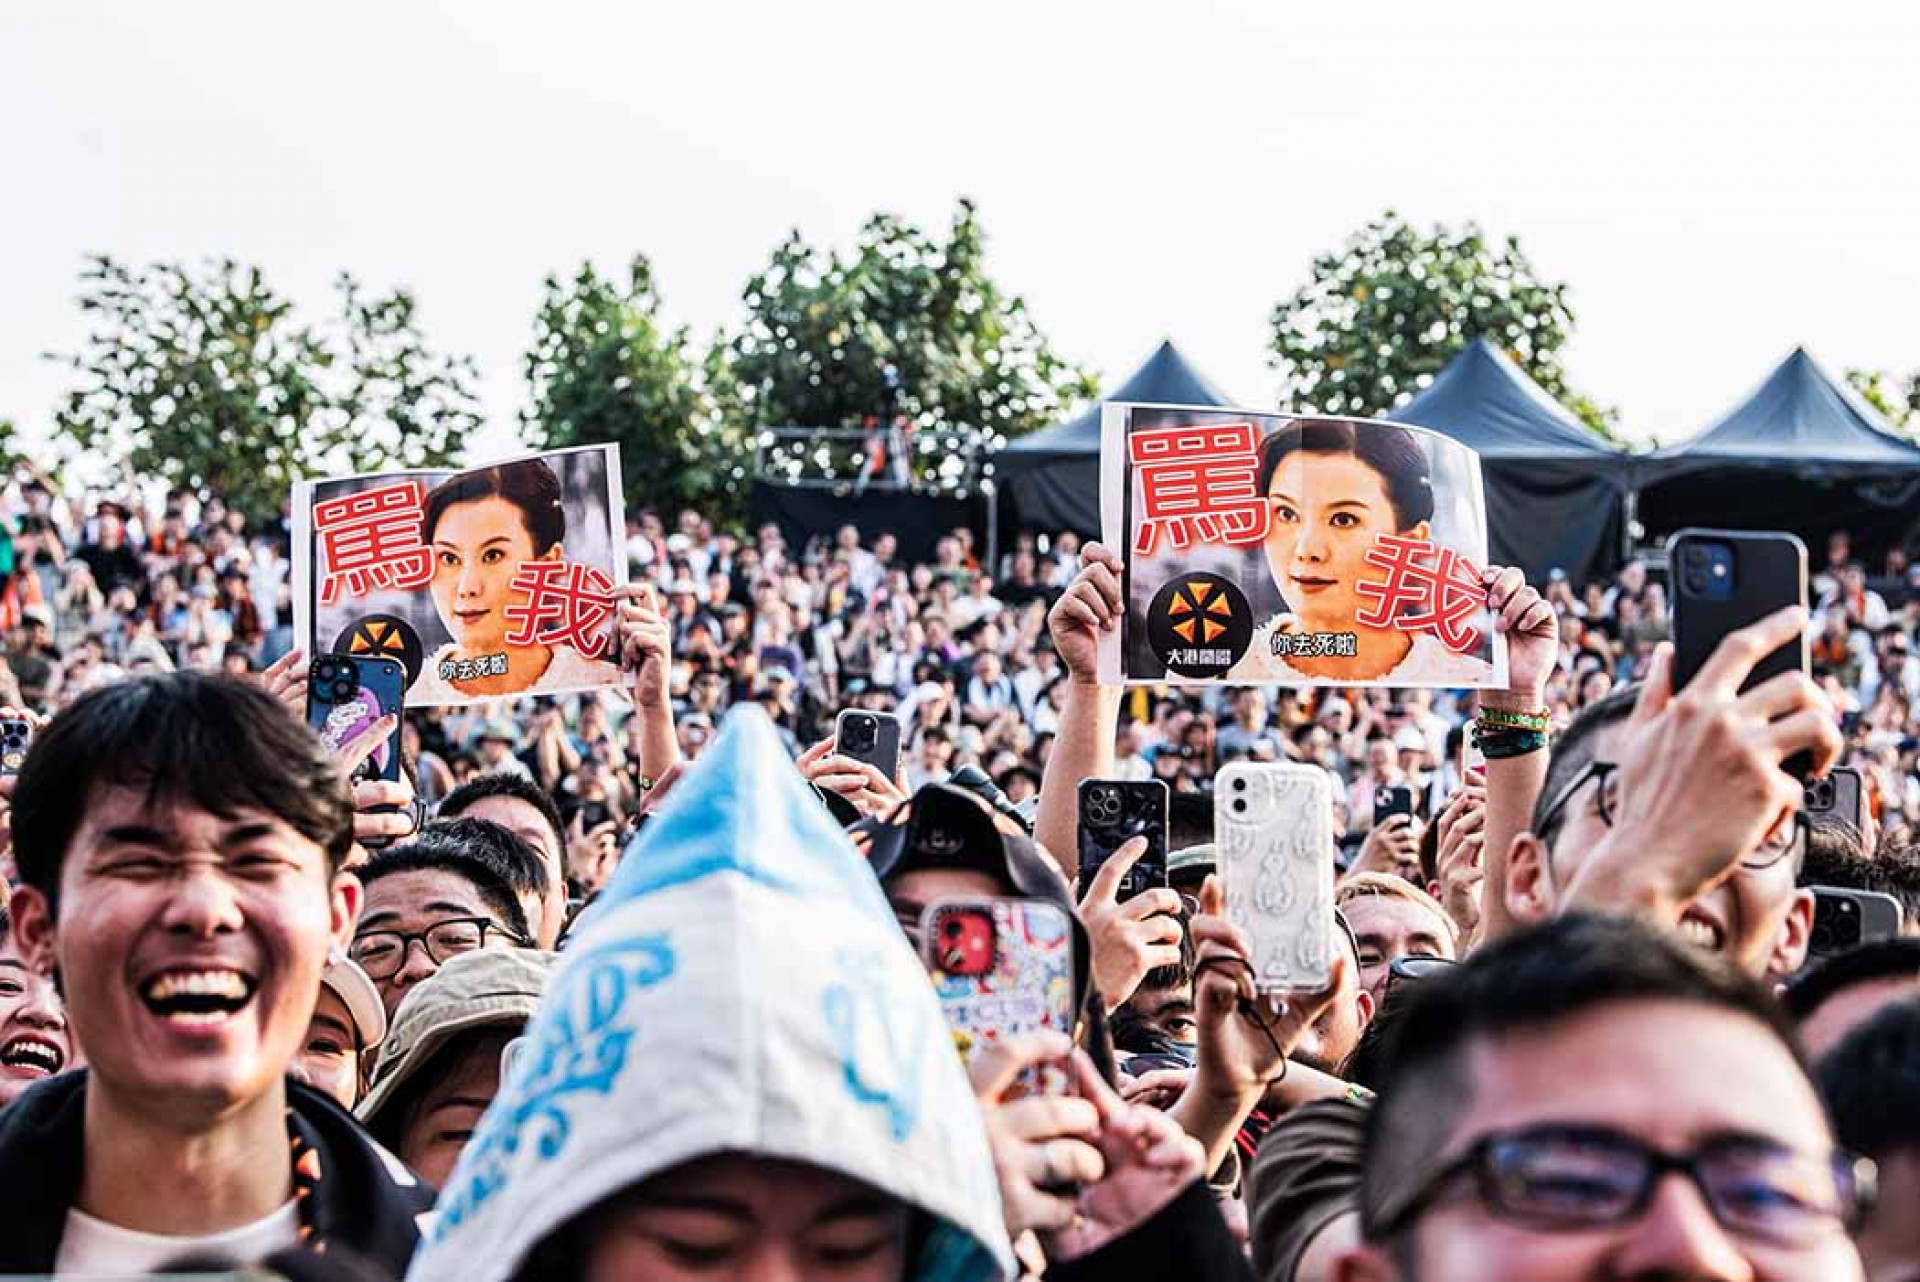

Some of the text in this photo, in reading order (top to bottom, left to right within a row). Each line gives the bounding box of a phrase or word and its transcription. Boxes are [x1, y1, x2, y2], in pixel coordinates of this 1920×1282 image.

[313, 481, 435, 602] 罵
[1128, 422, 1270, 554] 罵
[504, 560, 617, 657] 我
[1271, 633, 1357, 656] 你去死啦
[1356, 533, 1487, 652] 我
